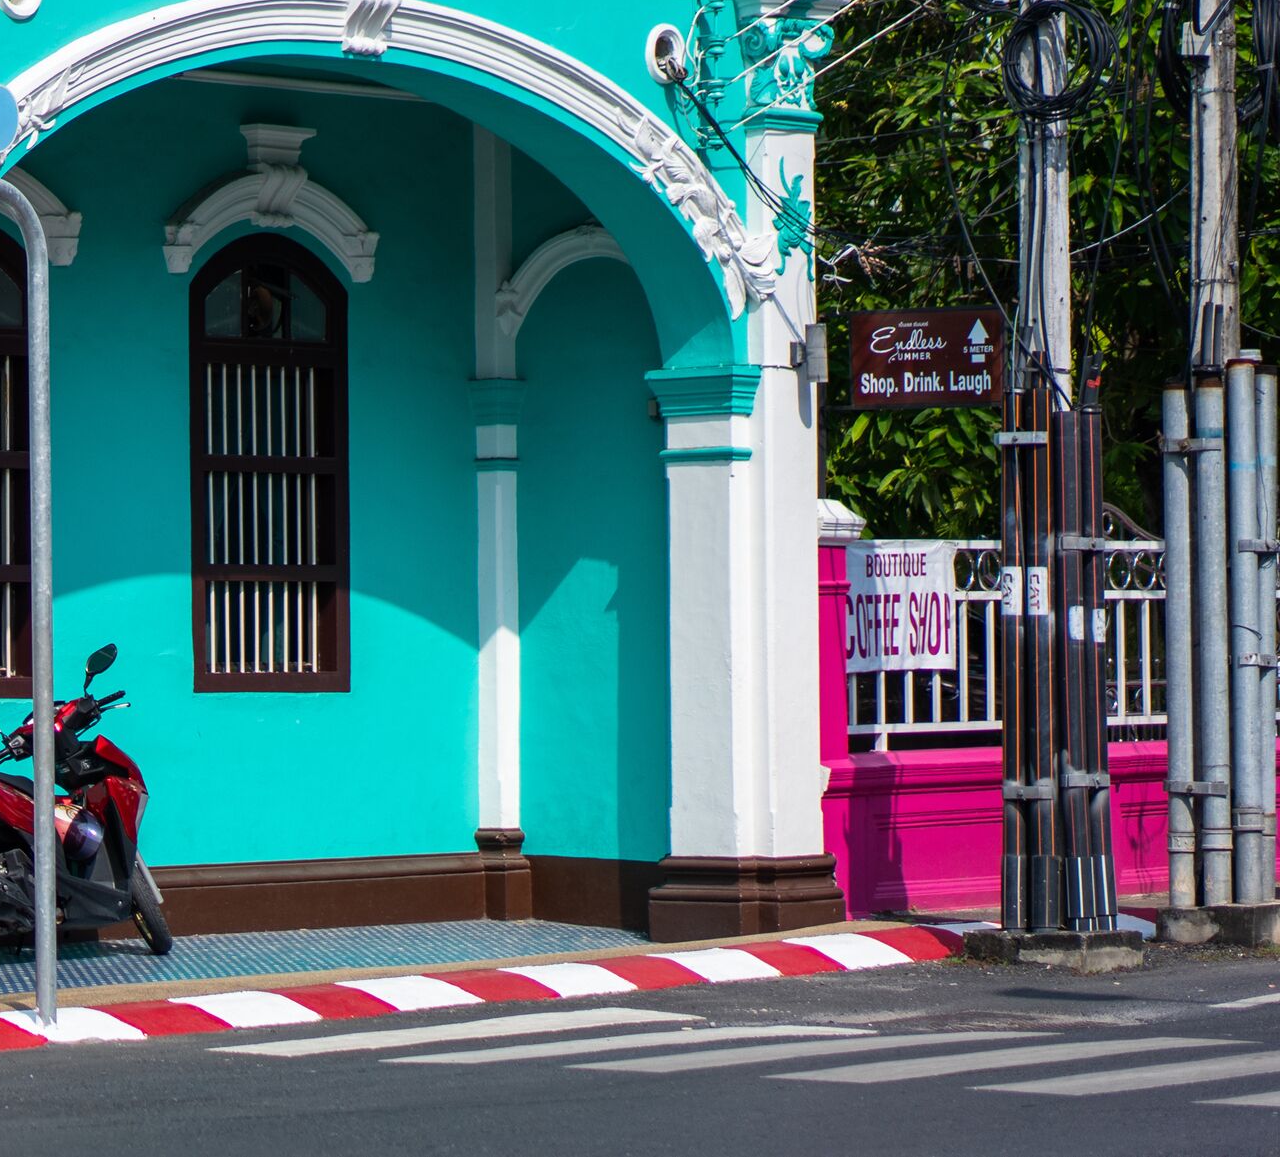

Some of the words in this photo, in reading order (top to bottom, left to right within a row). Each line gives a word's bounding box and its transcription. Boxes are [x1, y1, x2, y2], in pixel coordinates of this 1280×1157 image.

[870, 326, 947, 354] Endless
[969, 345, 993, 353] METER
[861, 373, 898, 397] Shop.
[904, 371, 944, 392] Drink.
[950, 369, 991, 395] Laugh
[865, 553, 927, 577] BOUTIQUE
